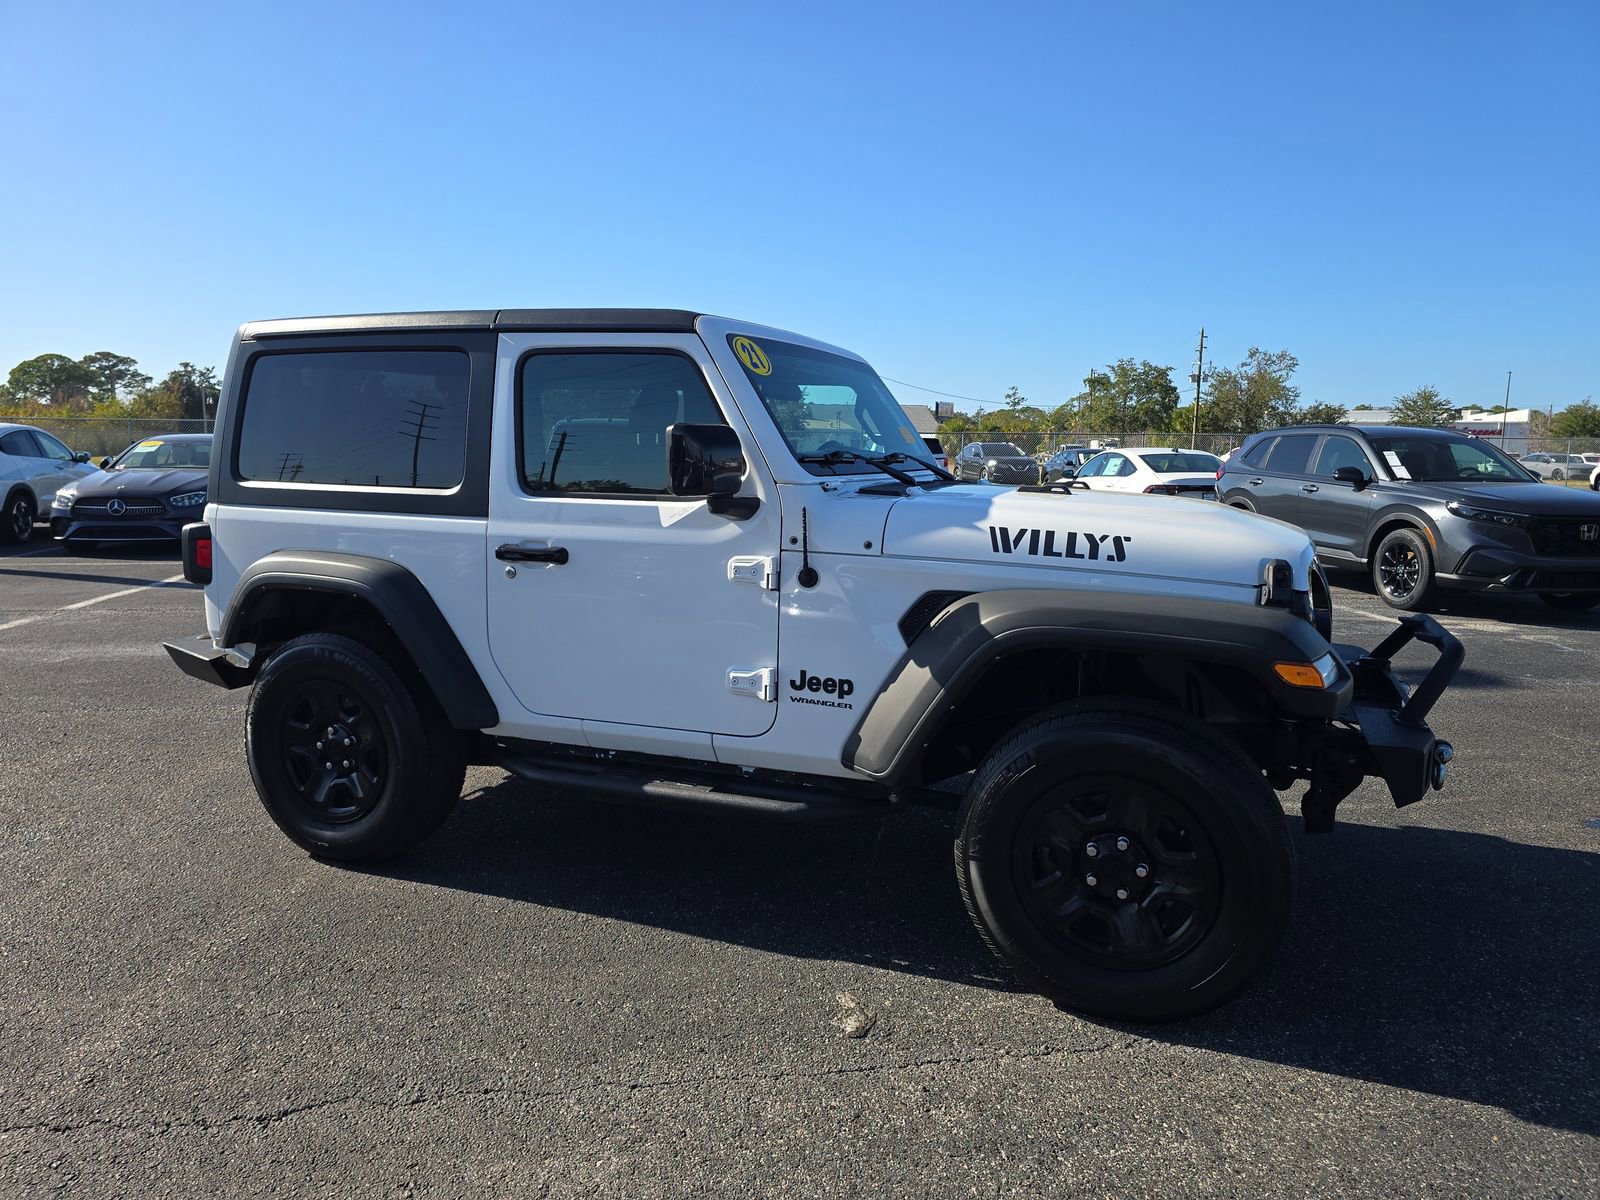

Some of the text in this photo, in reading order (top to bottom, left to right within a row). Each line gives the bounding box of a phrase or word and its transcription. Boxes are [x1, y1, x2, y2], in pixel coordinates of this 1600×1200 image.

[740, 342, 767, 369] 21
[989, 526, 1131, 562] WILLYS
[789, 669, 854, 700] Jeep
[789, 695, 853, 710] WRANGLER
